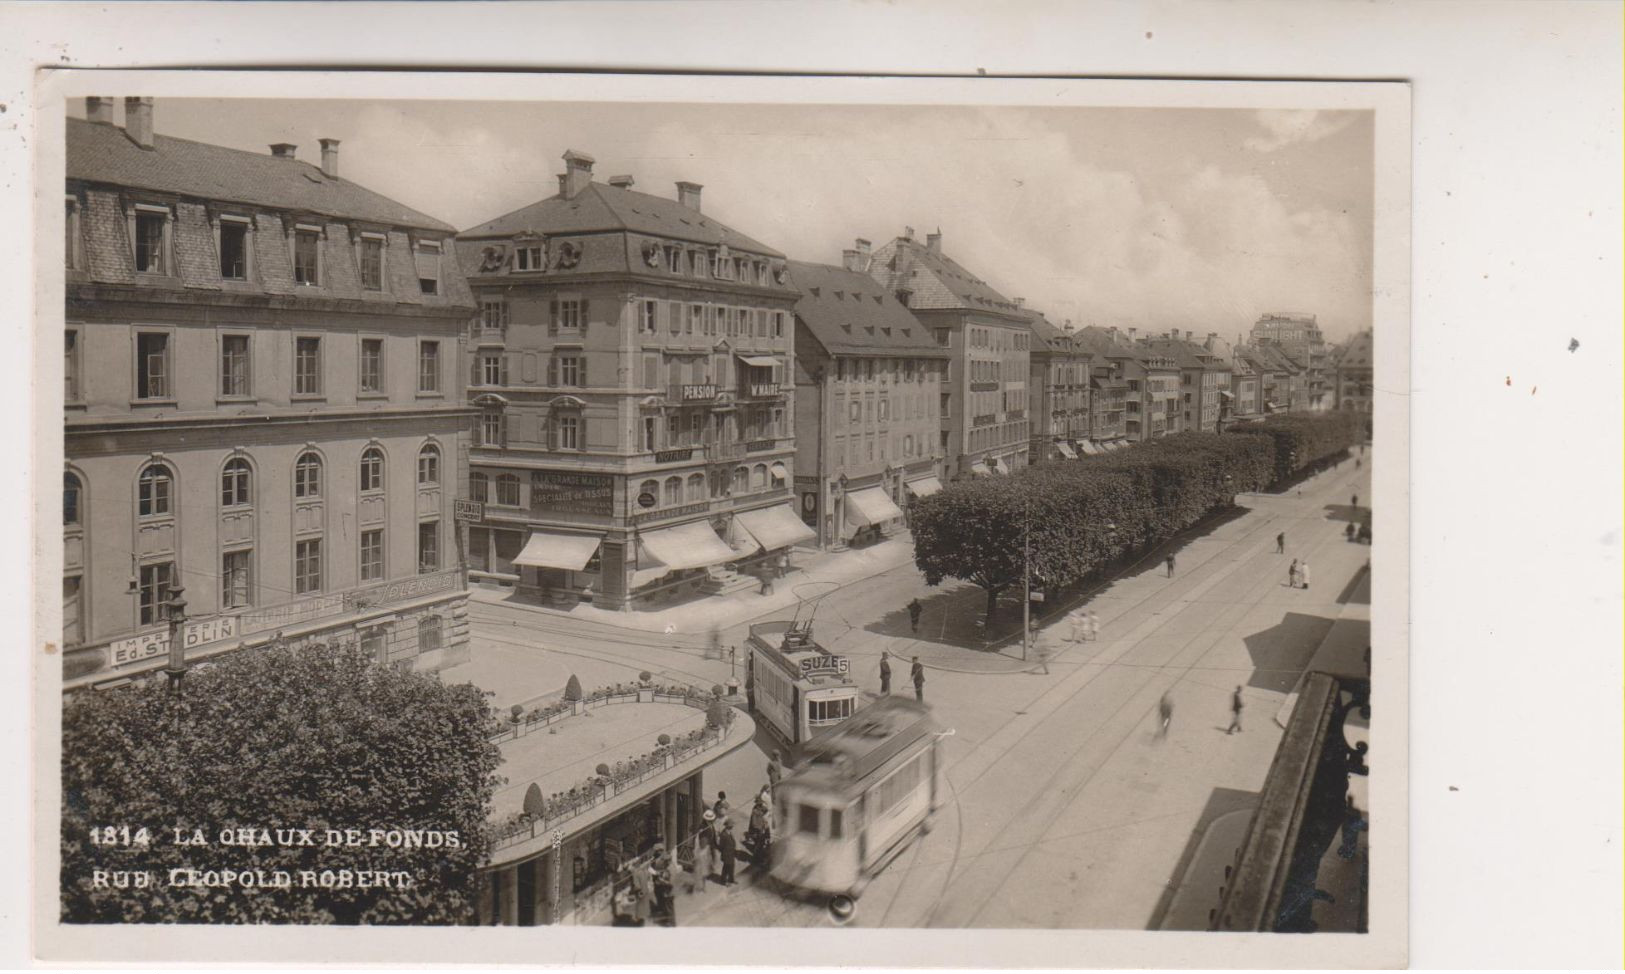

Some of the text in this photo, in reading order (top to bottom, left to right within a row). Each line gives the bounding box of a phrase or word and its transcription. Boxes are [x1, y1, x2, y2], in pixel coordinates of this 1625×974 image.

[684, 385, 715, 399] PENSION
[582, 476, 612, 486] MAISON
[117, 620, 229, 650] IMPRERIE
[801, 655, 848, 672] SUZE 5
